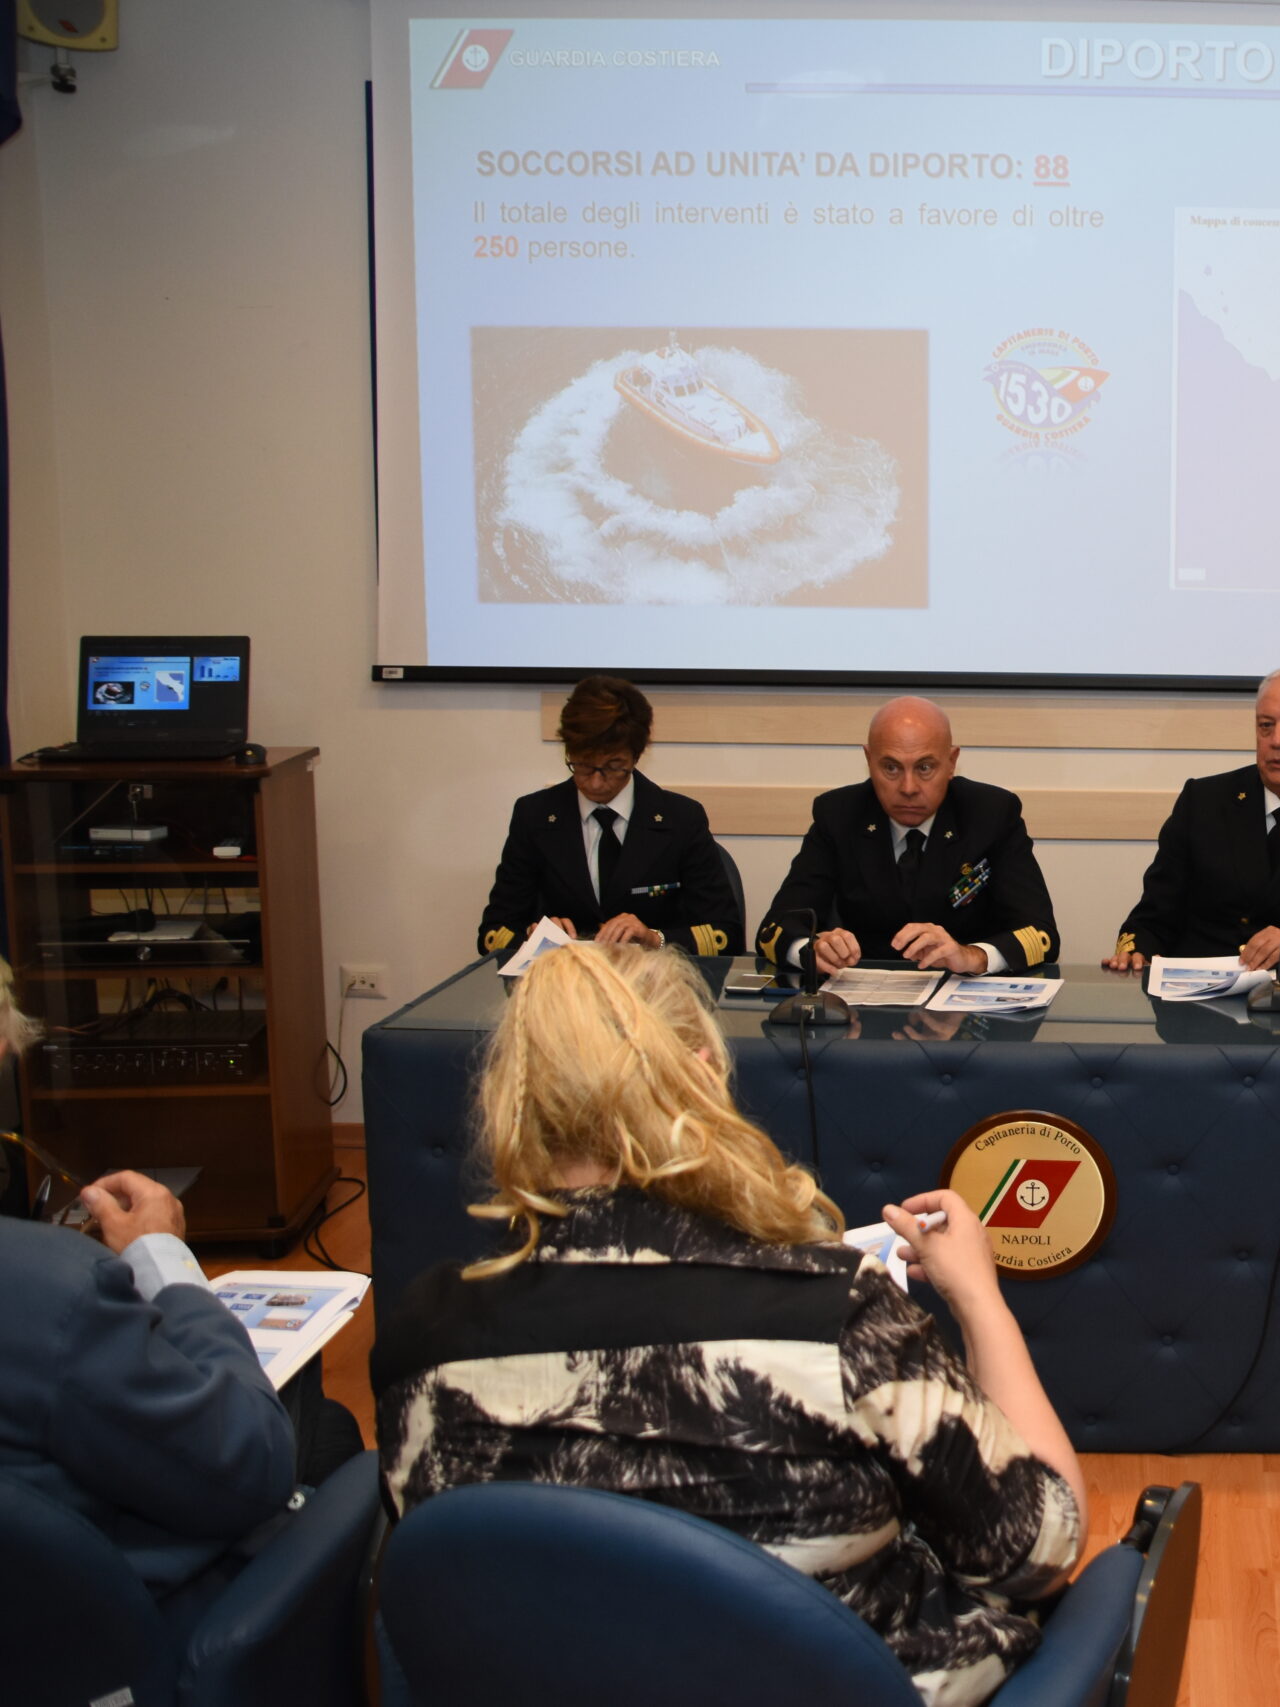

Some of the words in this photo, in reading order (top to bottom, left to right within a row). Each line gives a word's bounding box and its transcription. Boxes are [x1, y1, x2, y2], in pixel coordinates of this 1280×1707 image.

[510, 49, 606, 68] GUARDIA
[613, 49, 721, 68] COSTIERA
[1041, 37, 1275, 83] DIPORTO
[475, 149, 642, 178] SOCCORSI
[651, 150, 696, 177] AD
[815, 152, 861, 178] DA
[869, 152, 1023, 180] DIPORTO:
[1033, 153, 1070, 181] 88
[499, 201, 568, 225] totale
[582, 201, 641, 230] degli
[655, 201, 769, 225] interventi
[783, 202, 799, 225] è
[813, 203, 875, 226] stato
[888, 206, 904, 226] a
[918, 202, 999, 227] favore
[1011, 204, 1034, 227] di
[1048, 204, 1105, 228] oltre
[1189, 215, 1227, 229] Mappa
[1230, 215, 1241, 226] di
[472, 234, 519, 259] 250
[528, 239, 636, 264] persone.
[1072, 336, 1100, 366] PORTO
[999, 371, 1073, 425] 1530
[974, 1124, 1036, 1152] Capitaneria
[1039, 1126, 1052, 1138] di
[1054, 1131, 1081, 1155] Porto
[1001, 1234, 1052, 1246] NAPOLI
[992, 1251, 1024, 1267] ardia
[1027, 1246, 1073, 1267] Costiera
